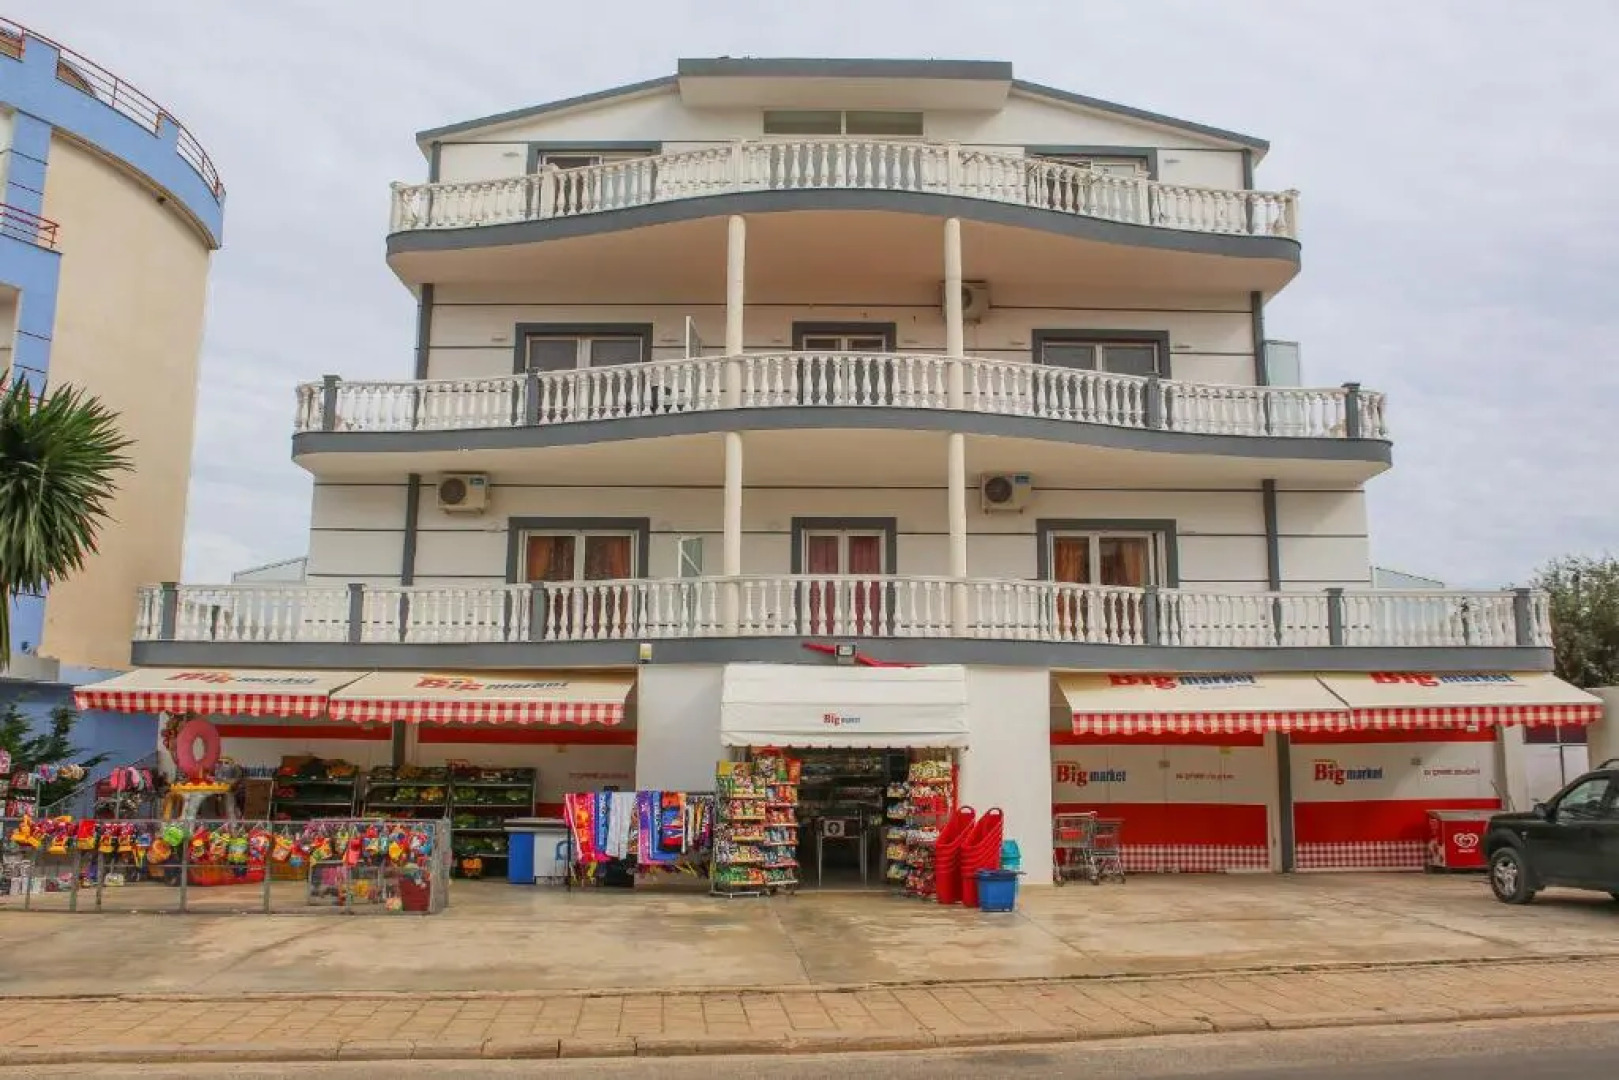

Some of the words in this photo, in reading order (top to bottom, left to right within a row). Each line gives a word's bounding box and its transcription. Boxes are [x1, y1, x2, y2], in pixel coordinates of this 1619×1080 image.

[1108, 673, 1176, 689] Big
[1368, 671, 1439, 687] Big
[823, 713, 841, 726] Big
[1056, 764, 1088, 787] Big
[1089, 769, 1126, 782] market
[1315, 763, 1343, 785] Big
[1347, 767, 1382, 780] market
